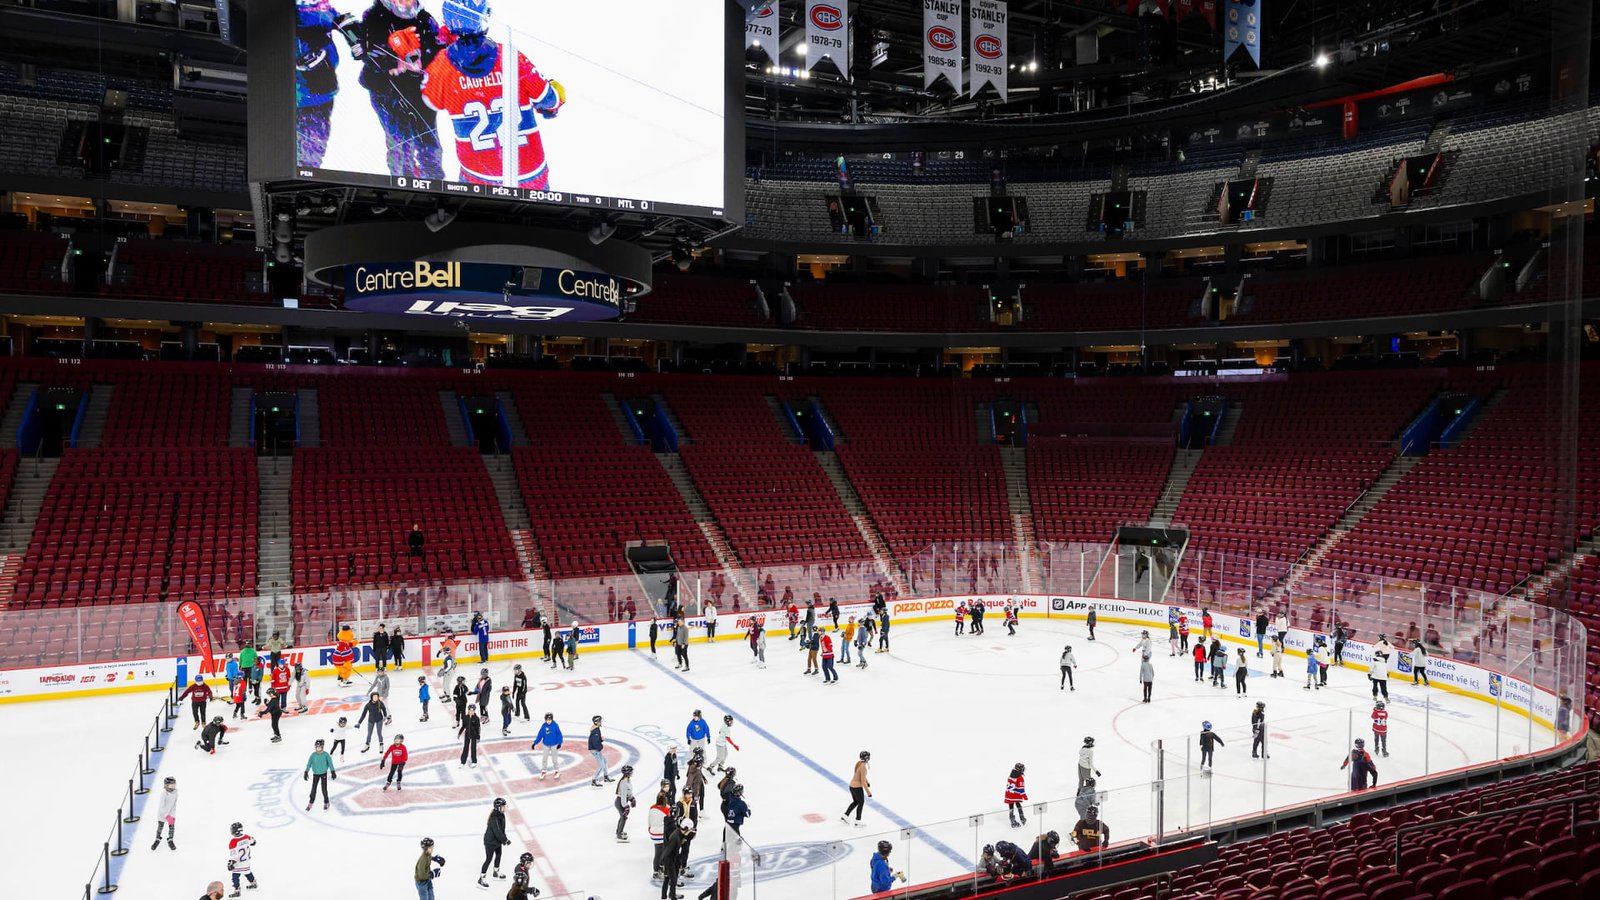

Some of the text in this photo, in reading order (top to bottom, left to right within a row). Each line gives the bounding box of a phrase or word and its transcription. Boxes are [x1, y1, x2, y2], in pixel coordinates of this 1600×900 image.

[925, 0, 960, 16] STANLEY
[979, 1, 999, 10] COUPE
[971, 8, 1006, 23] STANLEY
[983, 22, 995, 30] CUP
[811, 35, 842, 48] 1978-79
[927, 55, 957, 67] 1985-86
[975, 64, 1002, 76] 1992-93
[397, 177, 431, 190] 0 DET
[473, 185, 480, 193] 0
[530, 190, 562, 202] 20:00
[595, 197, 602, 205] 0
[618, 199, 649, 210] MTL 0
[894, 599, 954, 616] pizza pizza
[510, 638, 529, 648] TIRE
[1434, 658, 1457, 671] idées
[1456, 675, 1468, 685] vie
[1469, 678, 1480, 689] ici
[1505, 679, 1518, 689] Les
